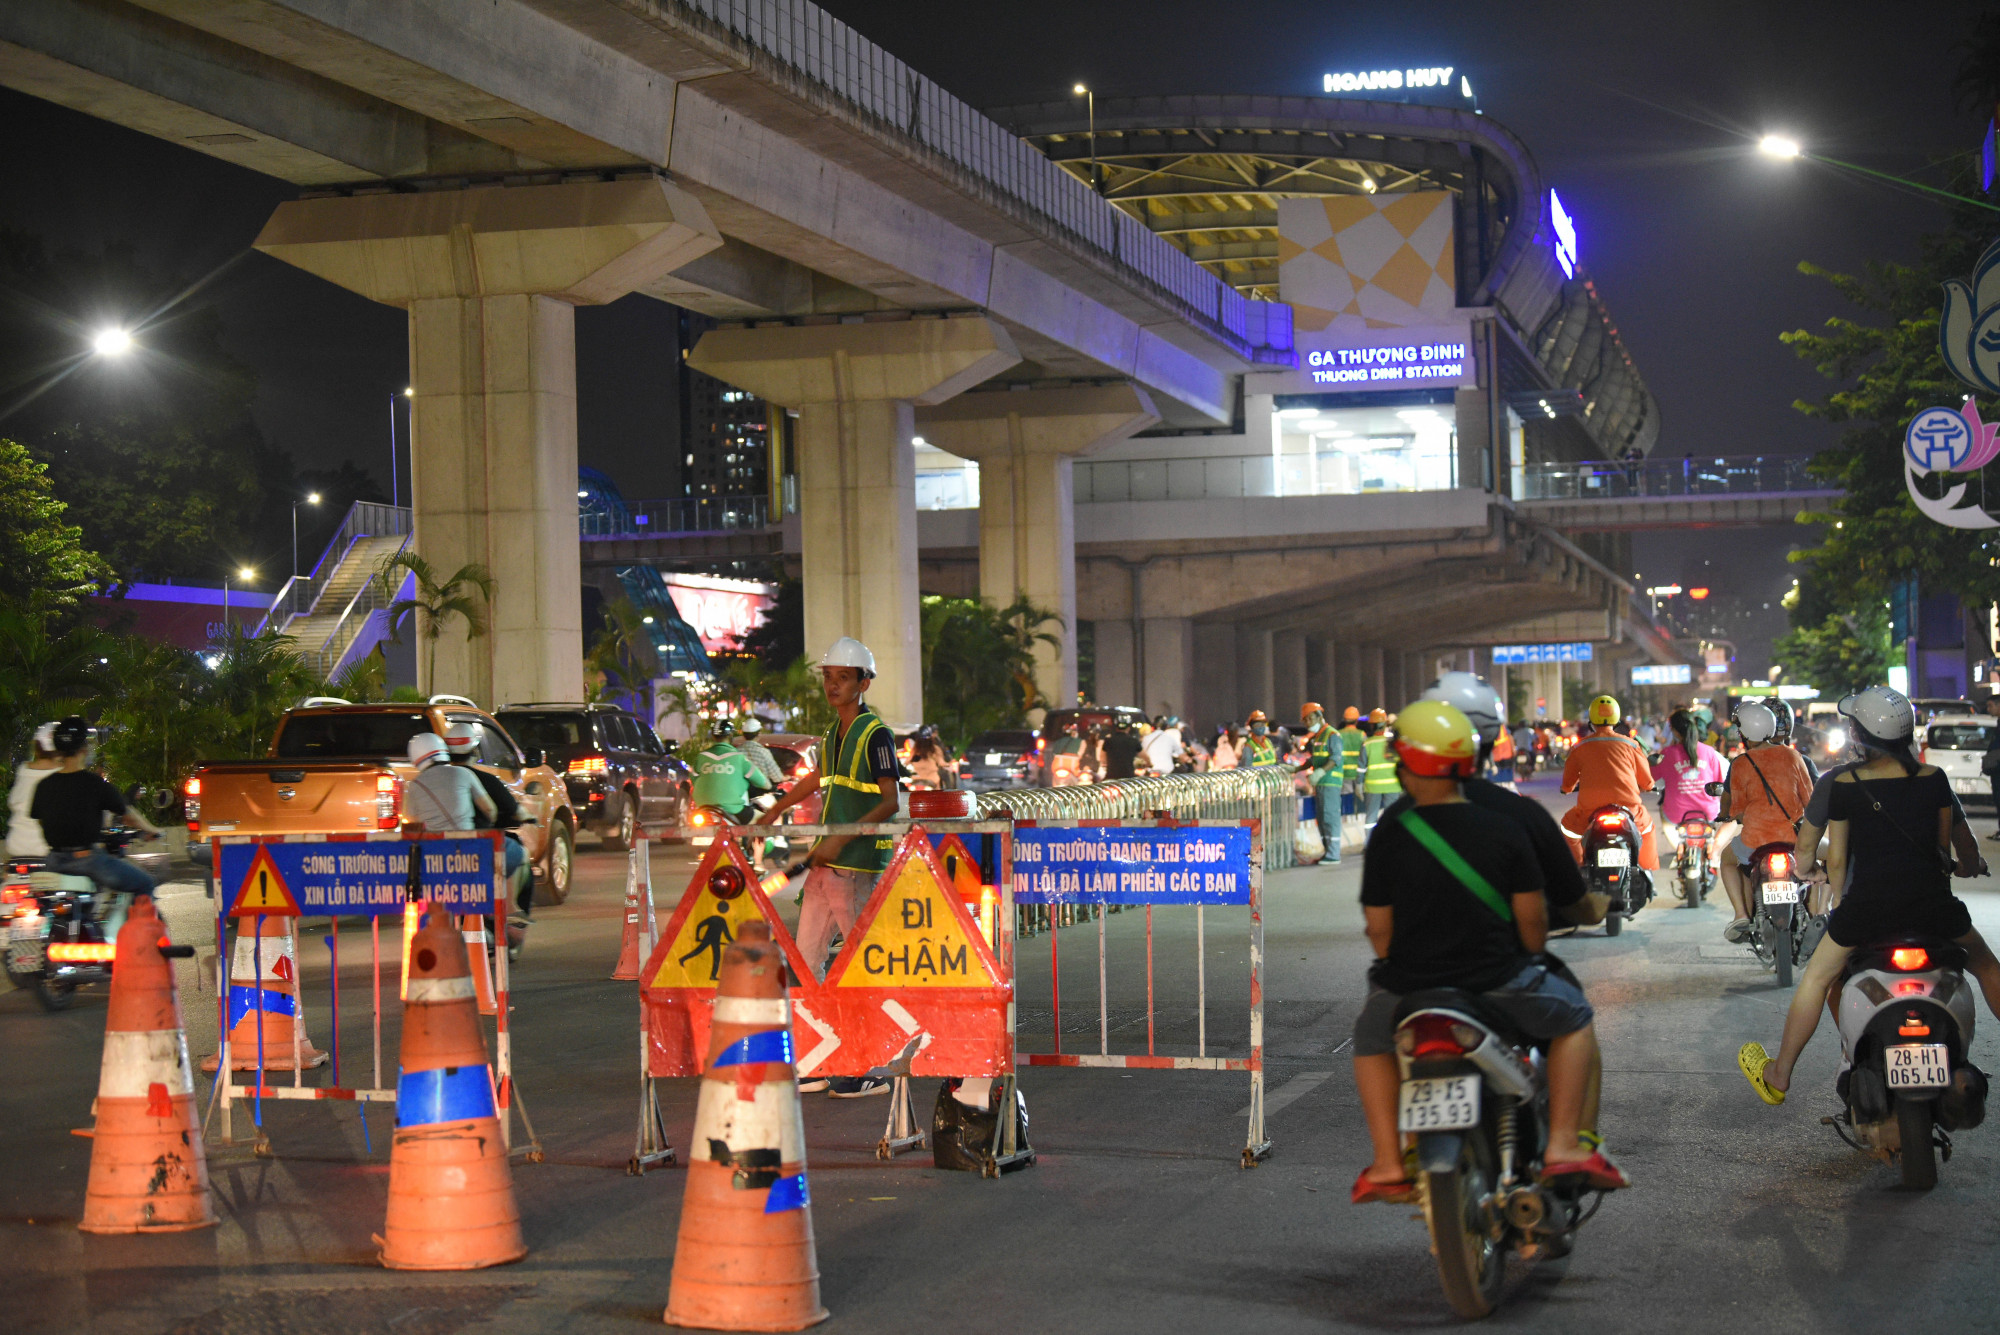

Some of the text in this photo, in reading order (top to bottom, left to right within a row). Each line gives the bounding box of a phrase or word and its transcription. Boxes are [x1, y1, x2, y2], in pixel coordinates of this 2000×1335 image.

[1323, 66, 1453, 92] HOANG HUY
[1308, 351, 1336, 366] GA
[1338, 346, 1417, 366] THƯỢNG
[1312, 364, 1462, 383] THUONG DINH STATION
[701, 762, 736, 775] Grab
[302, 851, 336, 875] CÔNG
[424, 854, 444, 874] THI
[446, 848, 480, 873] CÔNG
[1013, 837, 1226, 863] ÔNG TRƯỜNG ĐANG THI CÔNG
[304, 886, 325, 905] XIN
[368, 881, 394, 905] LÀM
[434, 879, 459, 904] CÁC
[462, 883, 488, 908] BẠN
[1013, 872, 1029, 893] IN
[1033, 865, 1056, 893] LỖI
[1121, 865, 1168, 893] PHIỀN
[1170, 867, 1201, 893] CÁC
[1205, 872, 1237, 896] BẠN
[901, 897, 932, 929] ĐI
[864, 937, 967, 982] CHẬM
[1893, 1048, 1939, 1066] 28-H1
[1890, 1067, 1946, 1085] 065.40
